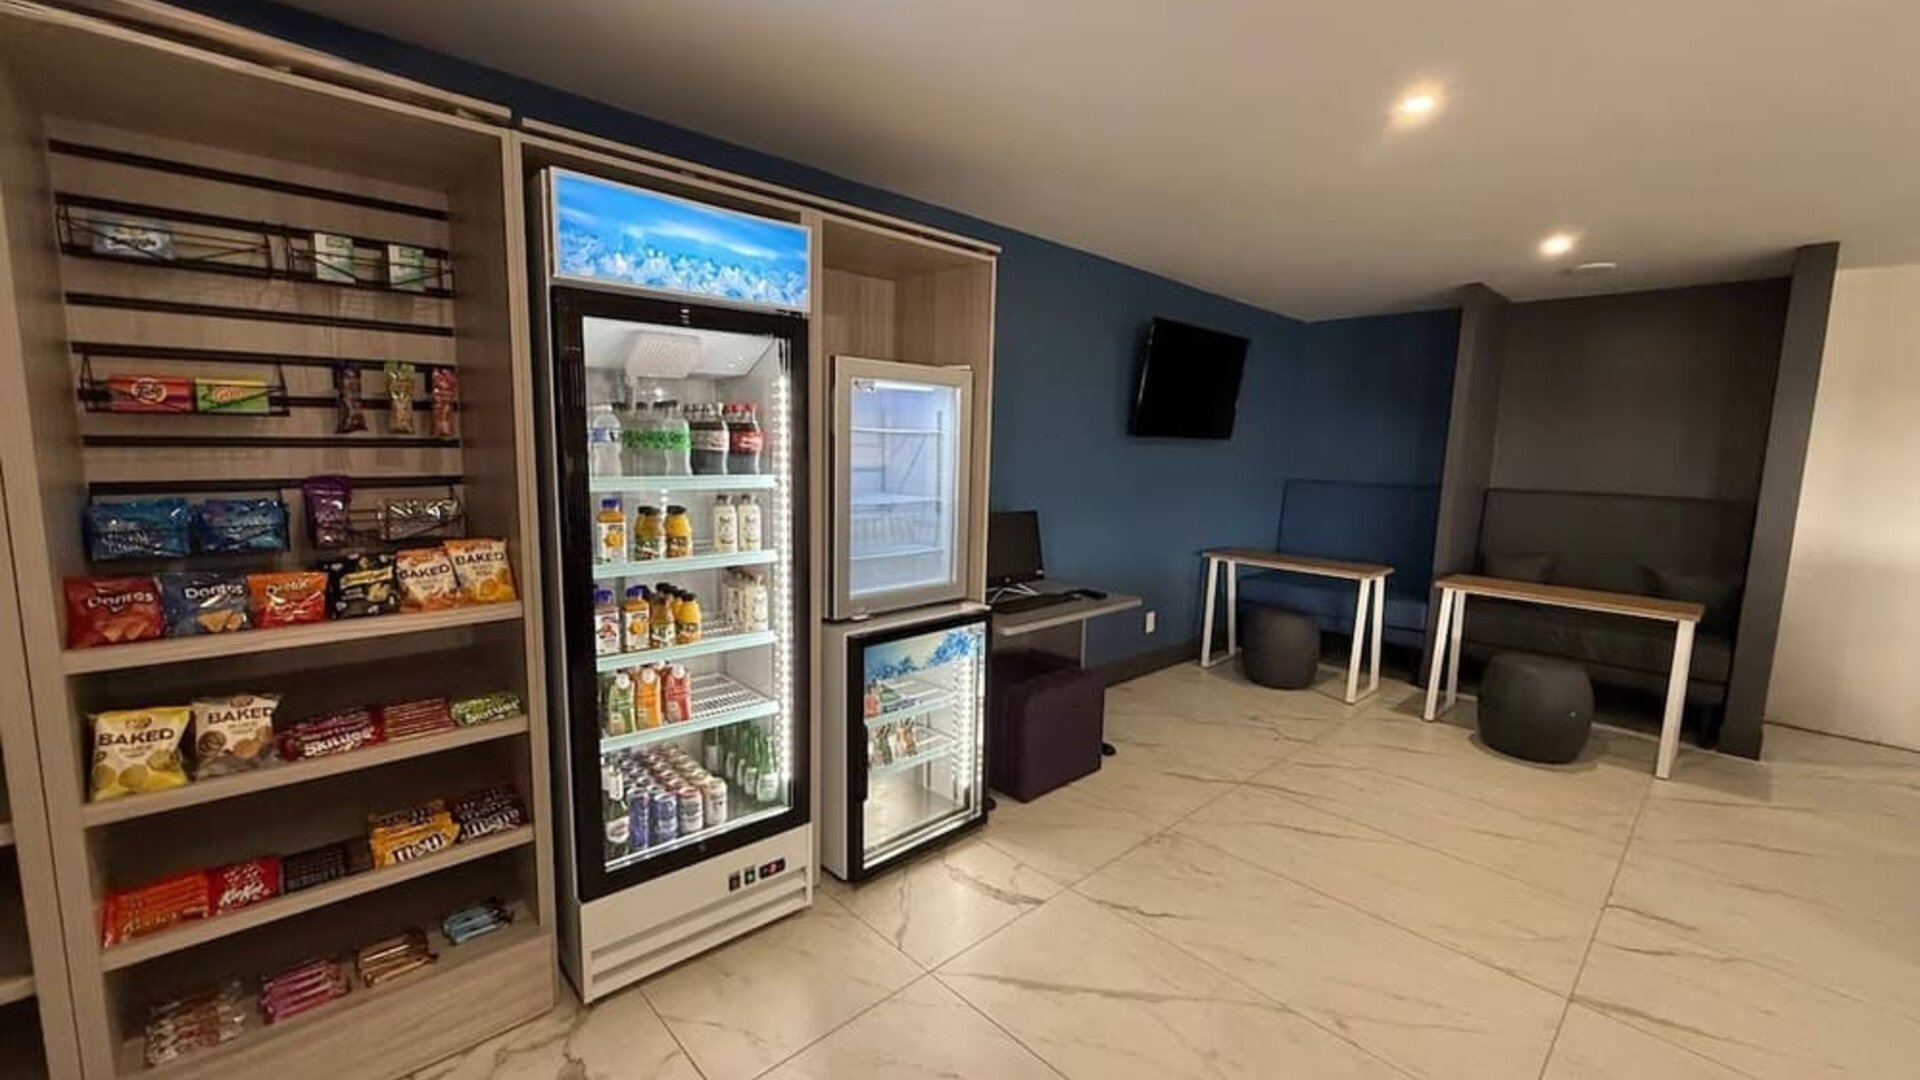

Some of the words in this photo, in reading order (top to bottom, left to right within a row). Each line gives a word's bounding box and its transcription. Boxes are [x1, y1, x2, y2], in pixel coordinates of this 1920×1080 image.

[455, 552, 504, 566] BAKED
[207, 706, 275, 725] BAKED
[98, 727, 175, 747] BAKED
